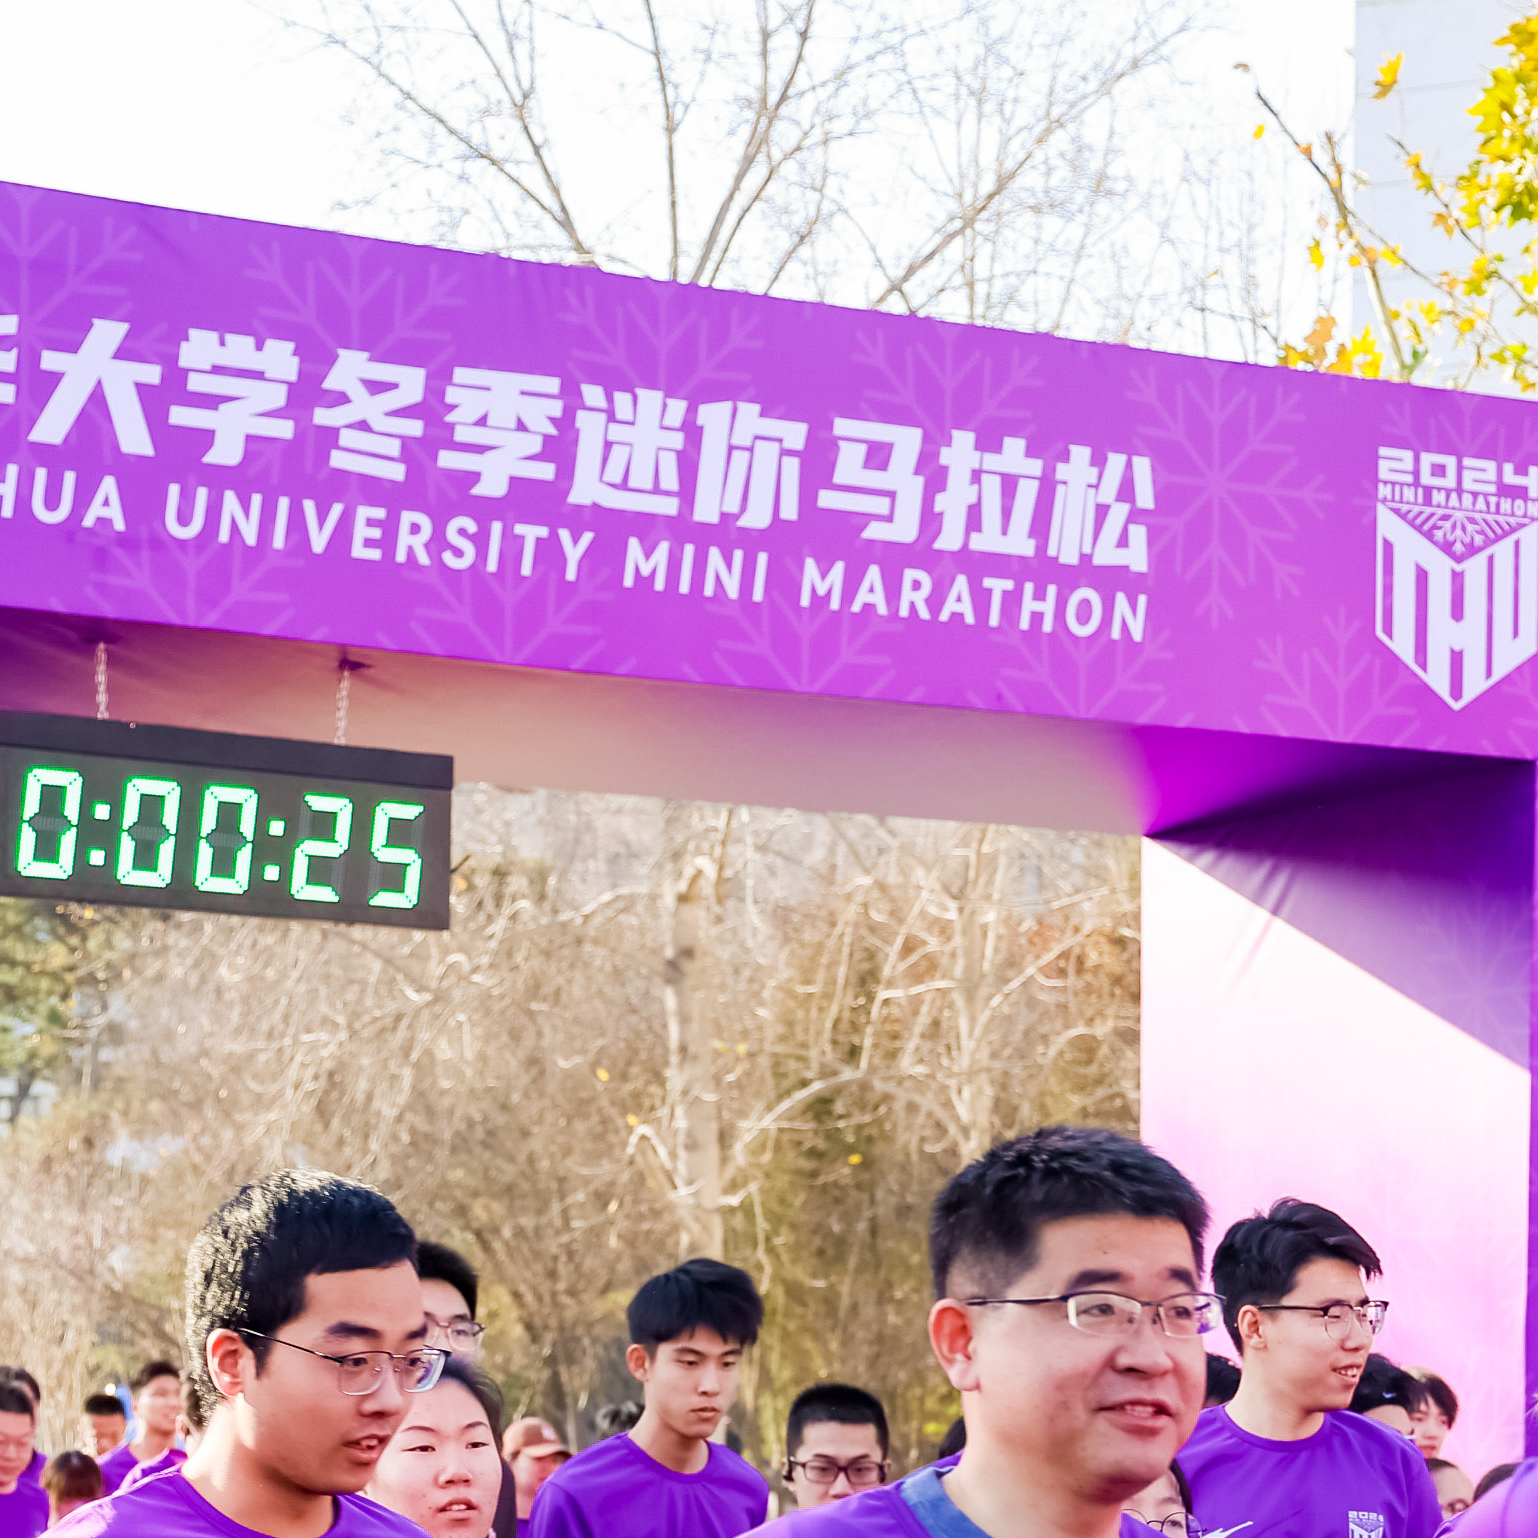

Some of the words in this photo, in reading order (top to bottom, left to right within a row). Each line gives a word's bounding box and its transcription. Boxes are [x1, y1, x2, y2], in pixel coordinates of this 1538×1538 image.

[162, 483, 595, 582] UNIVERSITY
[622, 536, 769, 603] MINI
[799, 556, 1149, 643] MARATHON
[1377, 481, 1424, 504] MINI
[16, 764, 425, 909] 0:00:25
